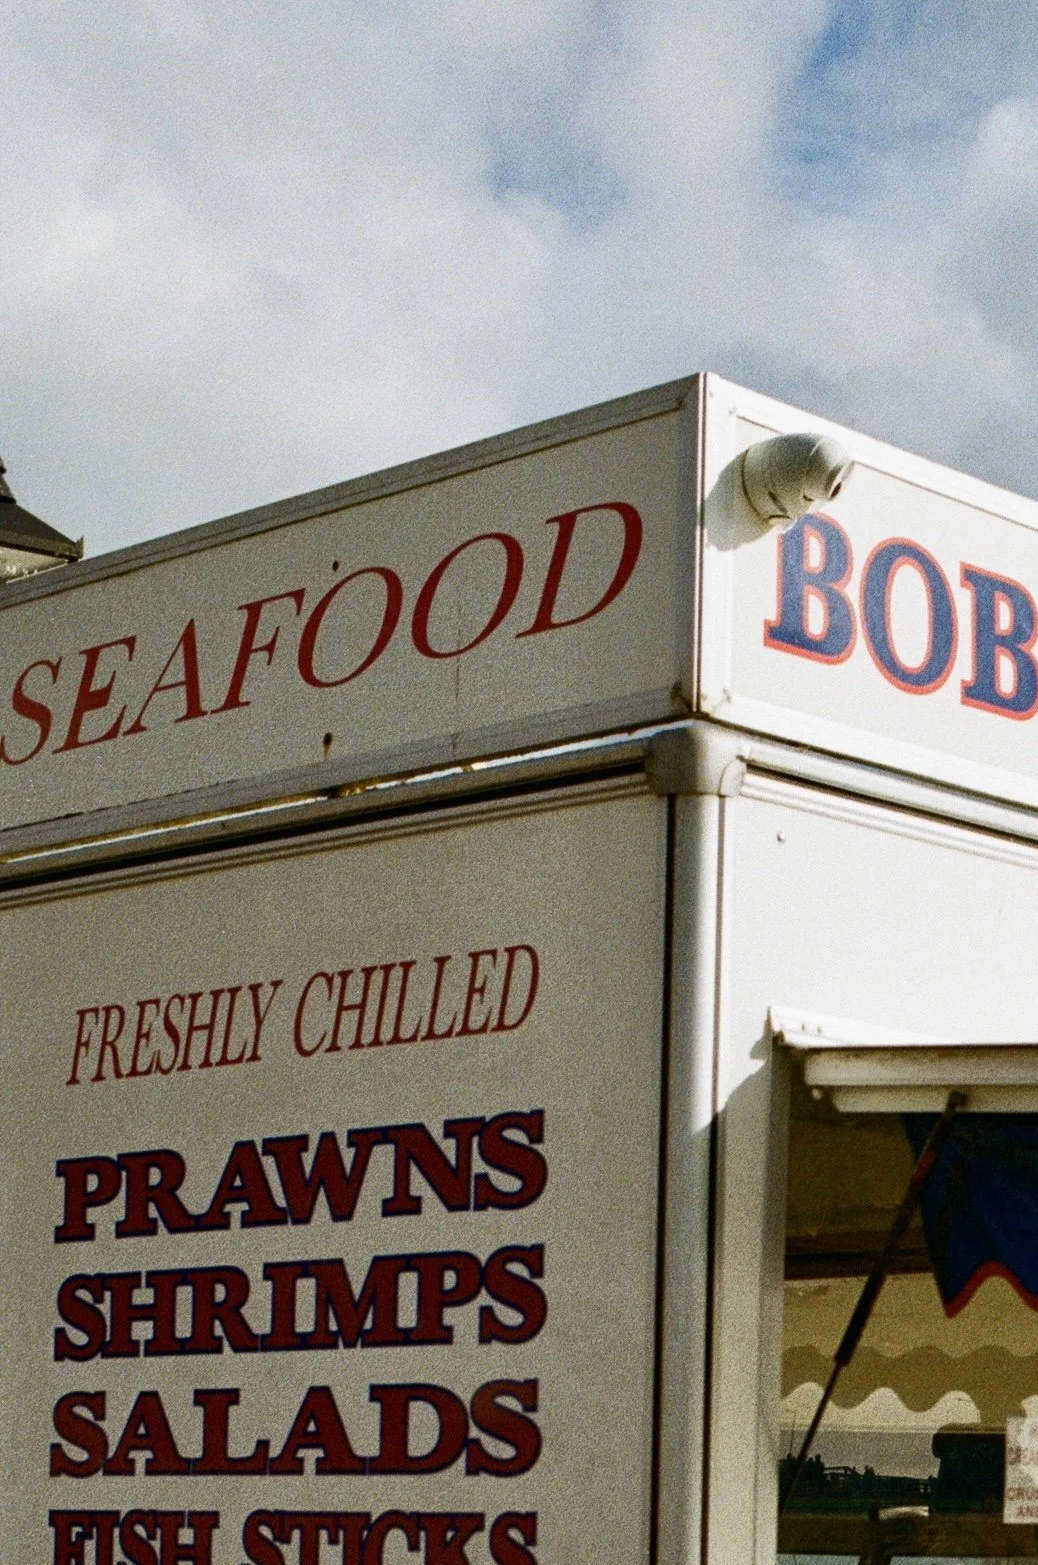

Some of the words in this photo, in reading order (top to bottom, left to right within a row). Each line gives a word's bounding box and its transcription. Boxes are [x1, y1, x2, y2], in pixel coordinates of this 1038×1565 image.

[0, 501, 643, 766] SEAFOOD
[66, 980, 283, 1086] FRESHLY
[293, 944, 540, 1057] CHILLED
[54, 1109, 548, 1243] PRAWNS
[54, 1244, 548, 1362] SHRIMPS
[49, 1378, 543, 1478] SALADS
